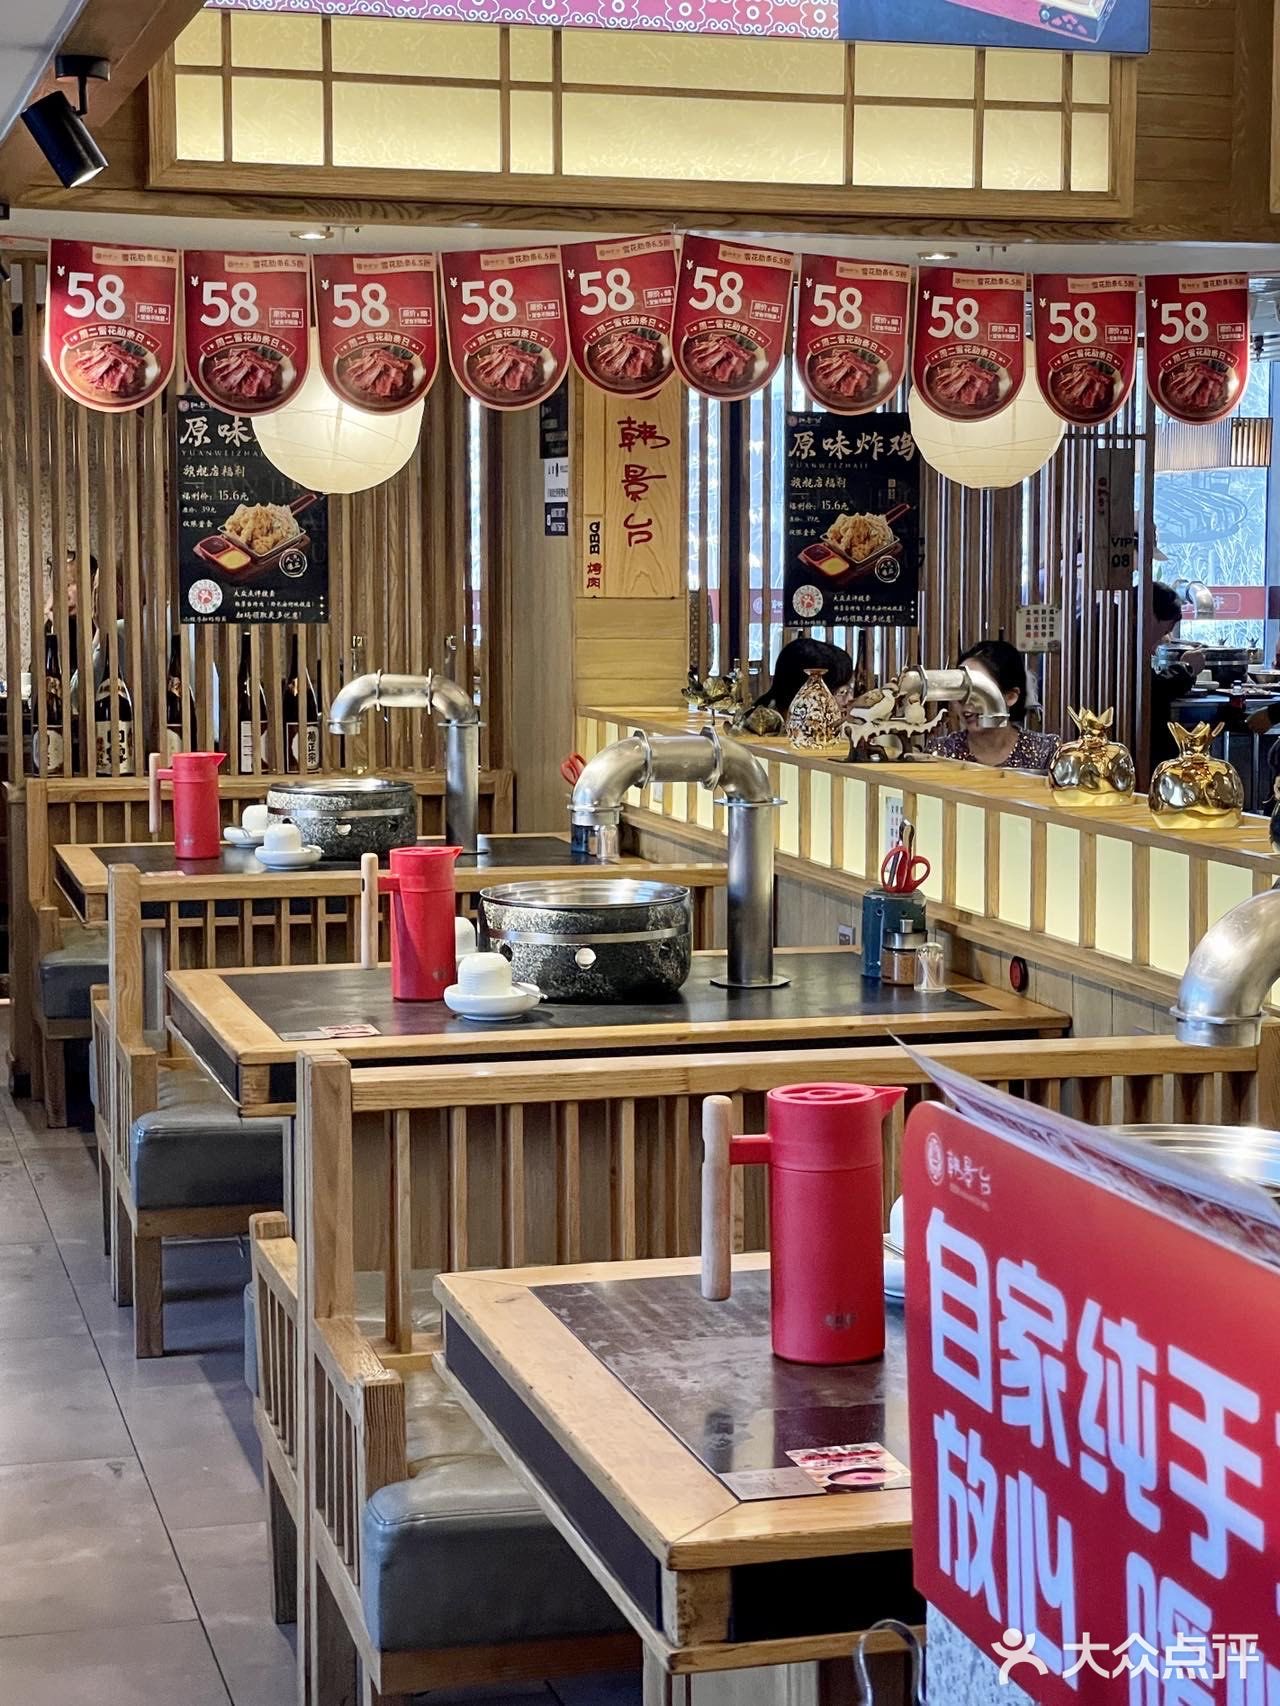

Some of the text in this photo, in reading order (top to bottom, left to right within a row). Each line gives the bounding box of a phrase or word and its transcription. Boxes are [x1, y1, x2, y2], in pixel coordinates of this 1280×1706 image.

[180, 416, 258, 447] 原味
[788, 430, 916, 461] 原味炸鸡
[183, 465, 245, 477] 旗舰店福利
[589, 521, 600, 555] BBQ
[1111, 537, 1133, 548] VIP
[1111, 554, 1131, 568] 08
[926, 1207, 1280, 1580] 自家纯手
